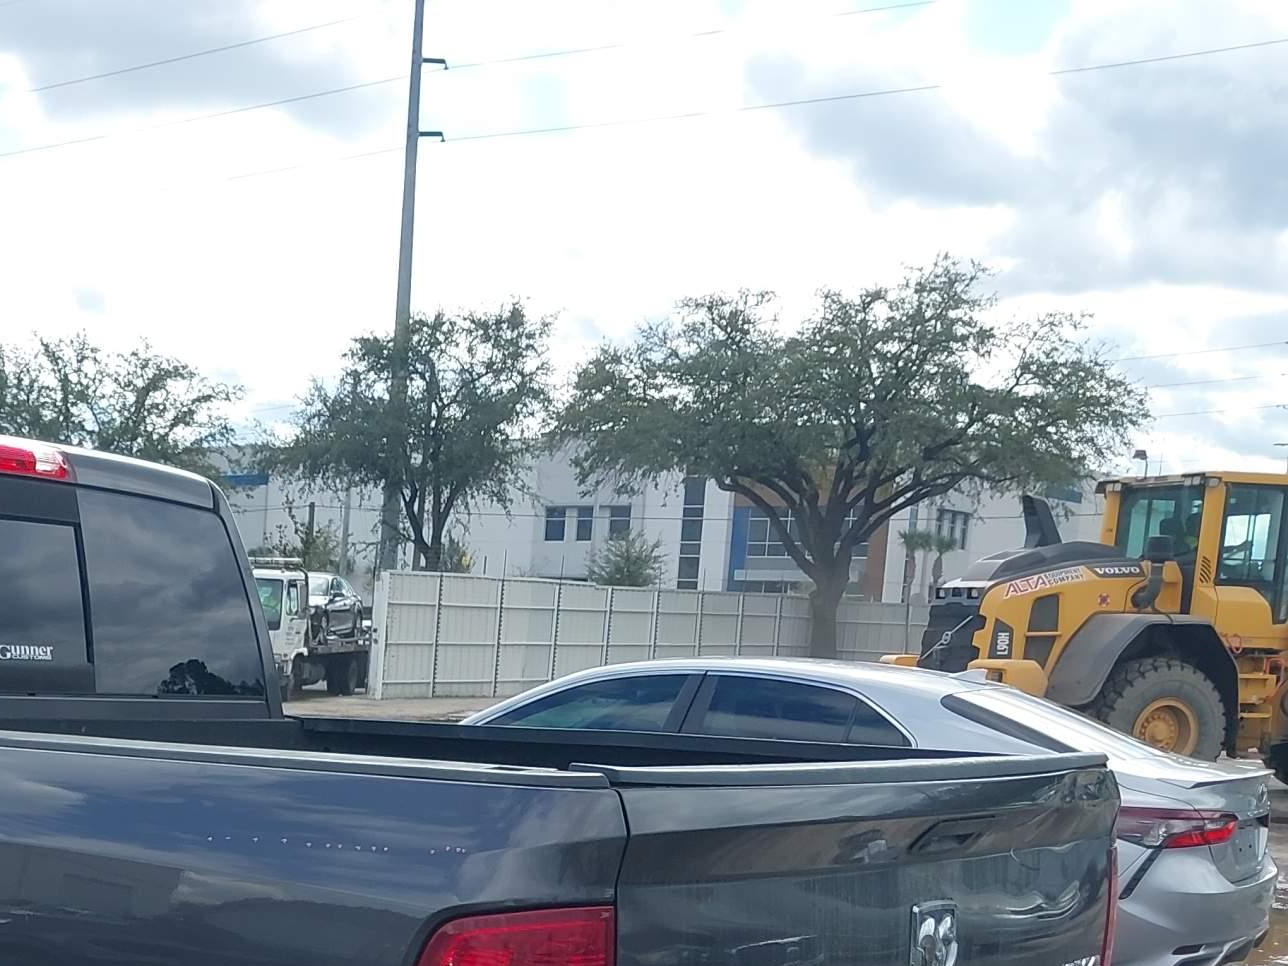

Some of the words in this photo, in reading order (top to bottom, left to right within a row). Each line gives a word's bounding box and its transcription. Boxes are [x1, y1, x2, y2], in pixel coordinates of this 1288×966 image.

[1093, 566, 1140, 575] VOLVO
[1004, 574, 1048, 598] ALTA
[996, 632, 1010, 655] L90H
